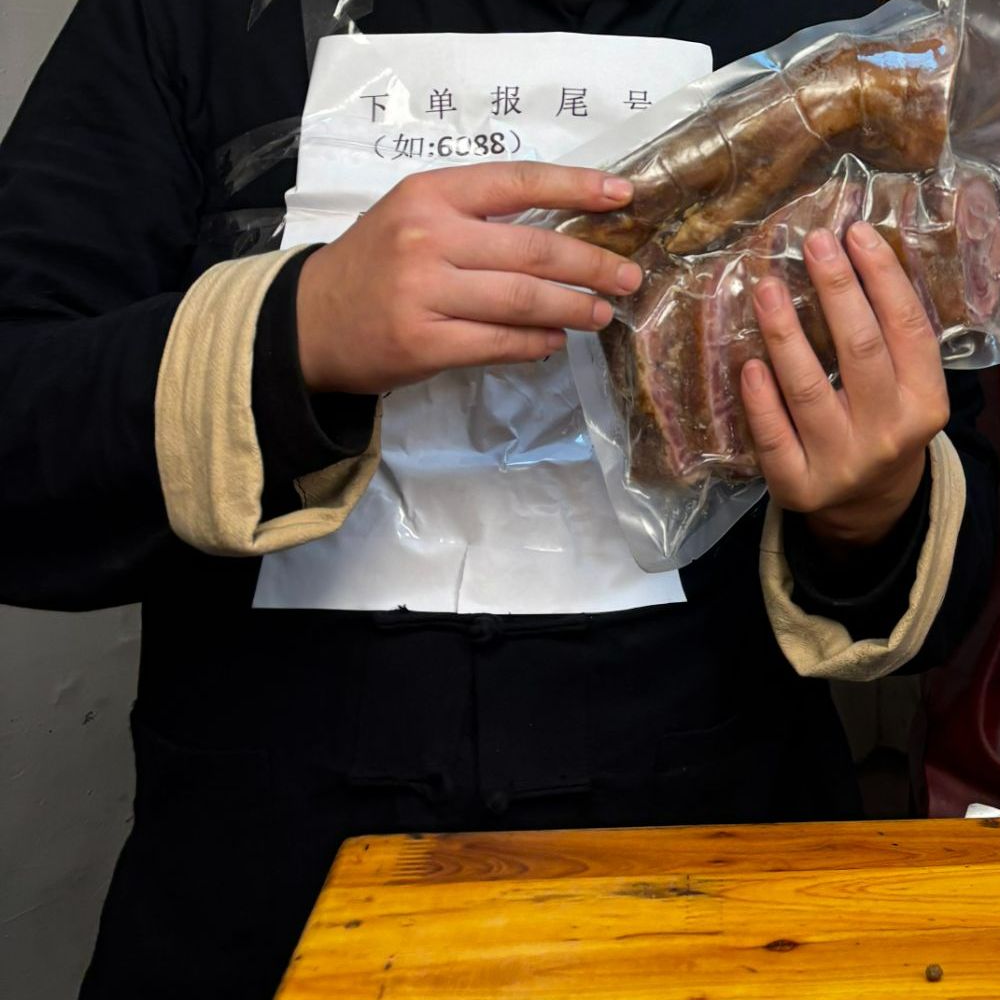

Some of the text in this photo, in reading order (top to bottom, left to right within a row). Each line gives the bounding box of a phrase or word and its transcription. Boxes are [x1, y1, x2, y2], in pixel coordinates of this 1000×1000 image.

[359, 85, 653, 123] 下单报尾号
